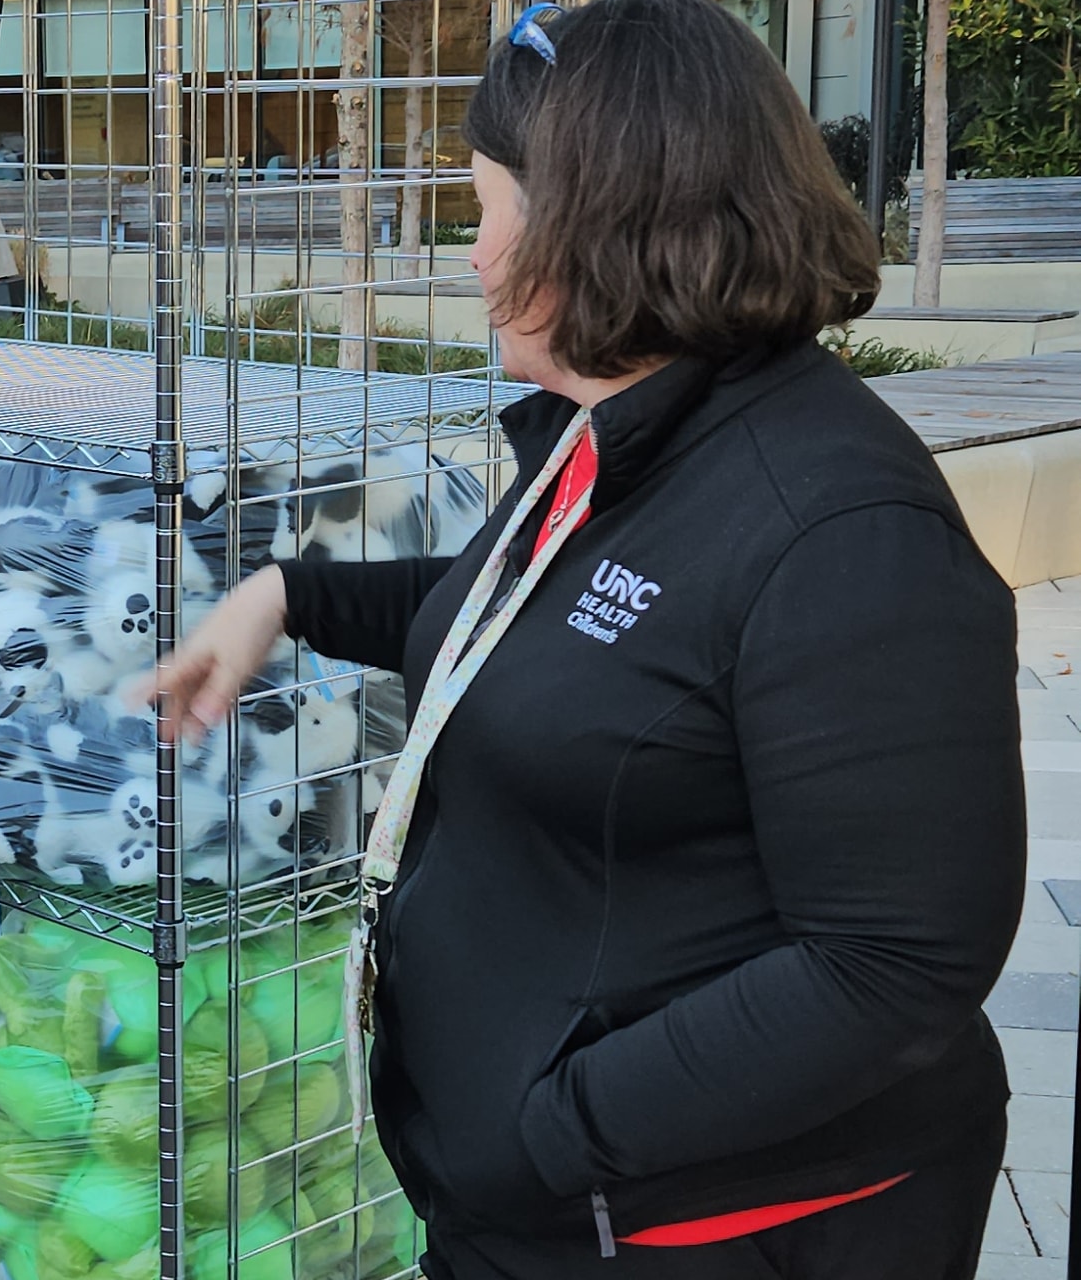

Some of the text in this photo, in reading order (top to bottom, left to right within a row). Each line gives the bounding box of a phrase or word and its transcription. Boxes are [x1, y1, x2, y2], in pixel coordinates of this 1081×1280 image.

[591, 557, 662, 611] UNC
[566, 610, 619, 645] Children's
[576, 591, 639, 629] HEALTH
